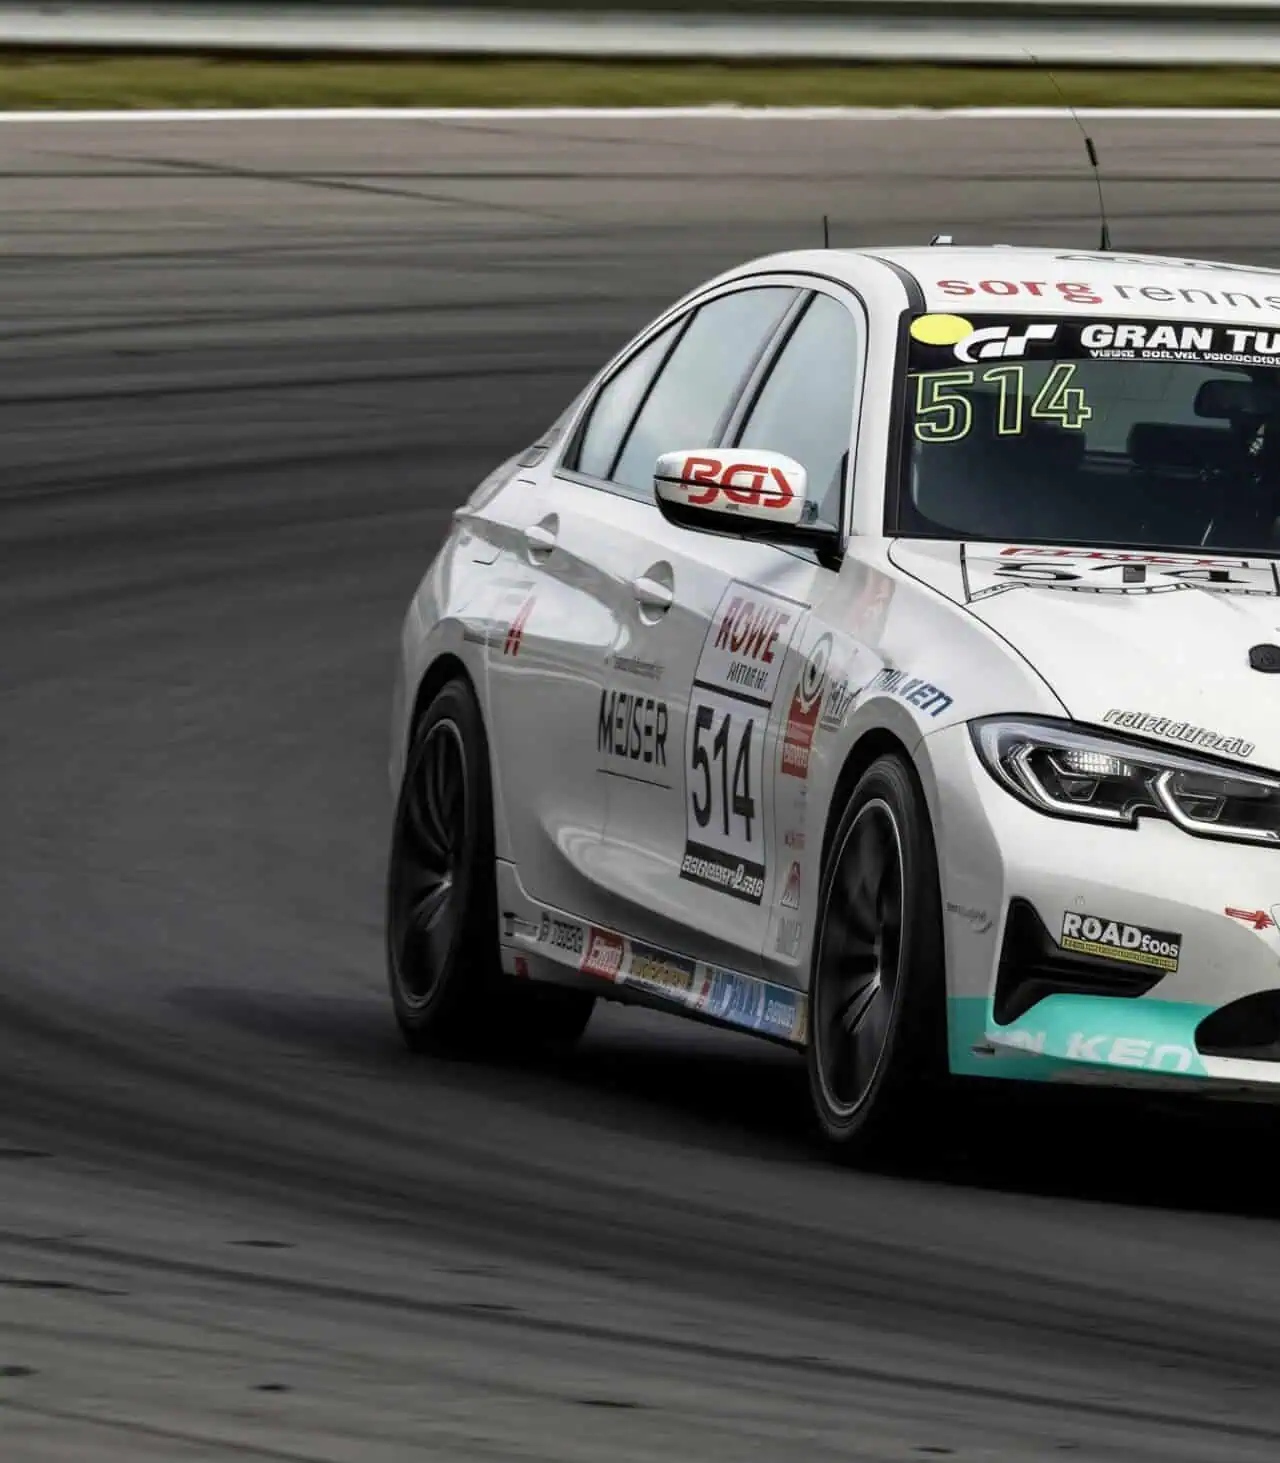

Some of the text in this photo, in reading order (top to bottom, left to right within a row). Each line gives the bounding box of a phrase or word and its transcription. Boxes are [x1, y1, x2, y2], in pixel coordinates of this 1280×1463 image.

[937, 280, 1103, 304] sorg
[1080, 324, 1213, 350] GRAN
[914, 364, 1092, 442] 514
[692, 704, 756, 842] 514
